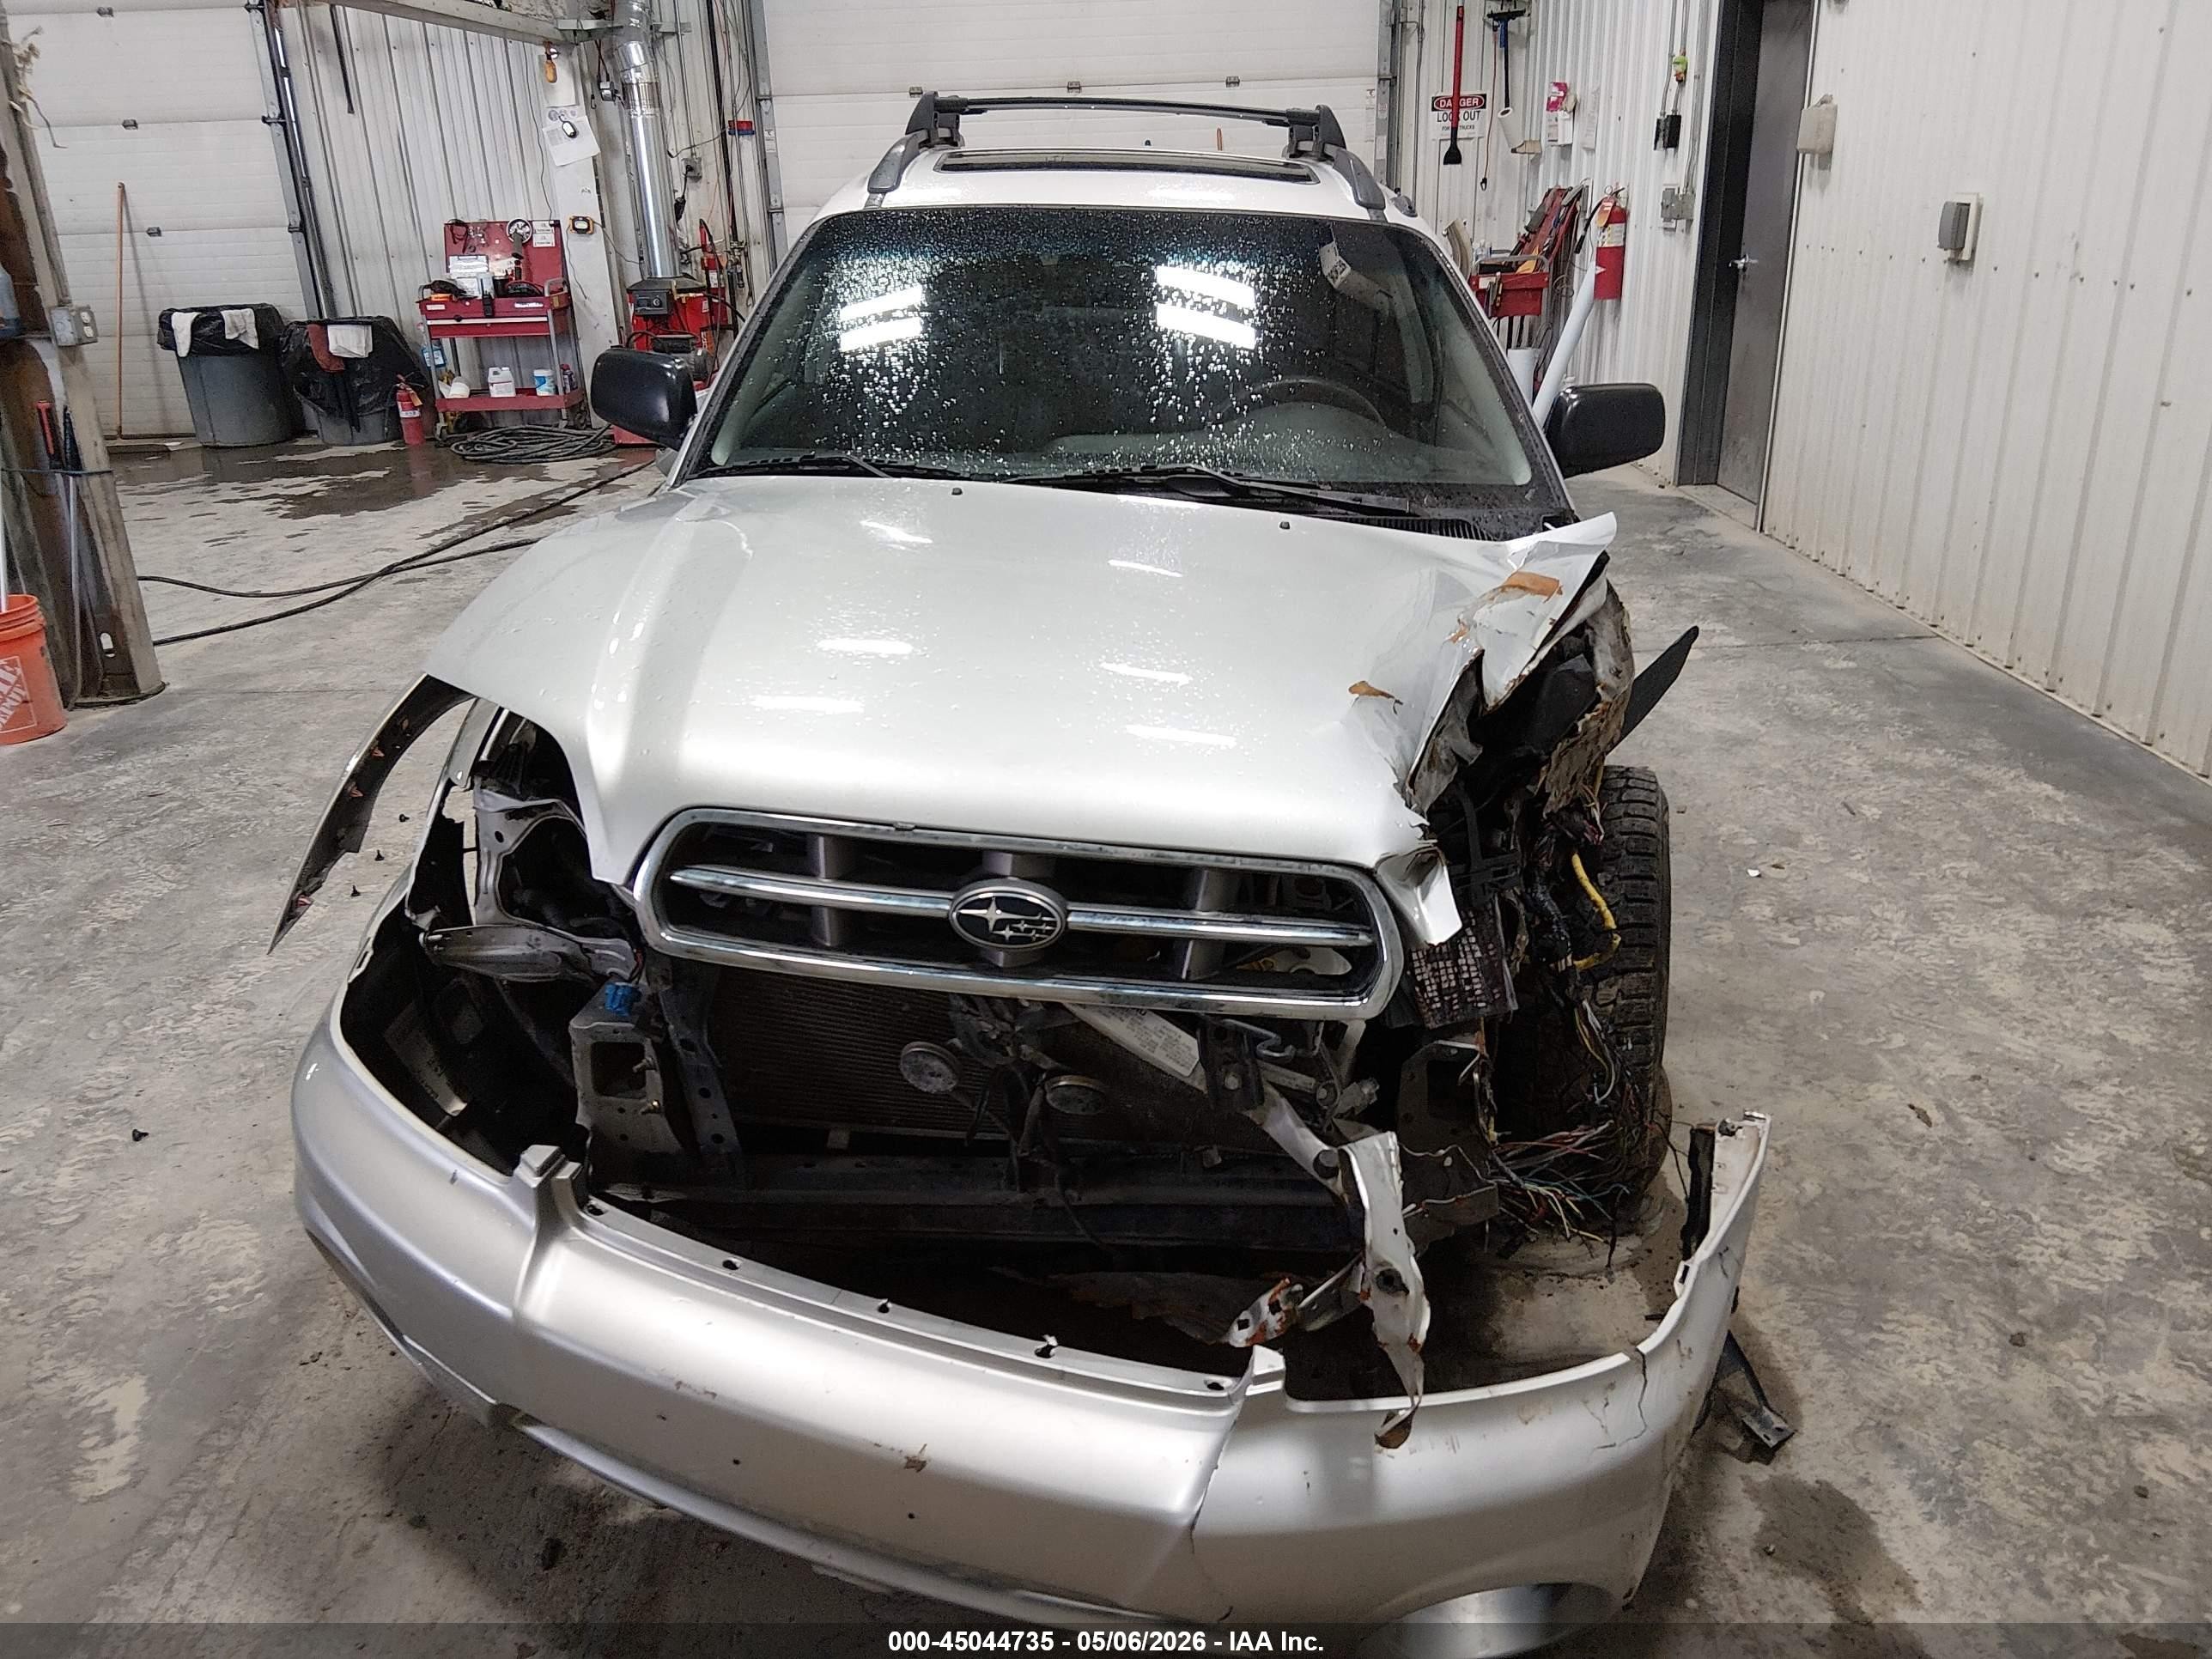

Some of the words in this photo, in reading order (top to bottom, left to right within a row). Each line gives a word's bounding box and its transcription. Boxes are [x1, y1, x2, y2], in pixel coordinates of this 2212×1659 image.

[1439, 98, 1479, 107] DAGER
[1437, 112, 1459, 122] LOC
[1463, 110, 1480, 121] OUT
